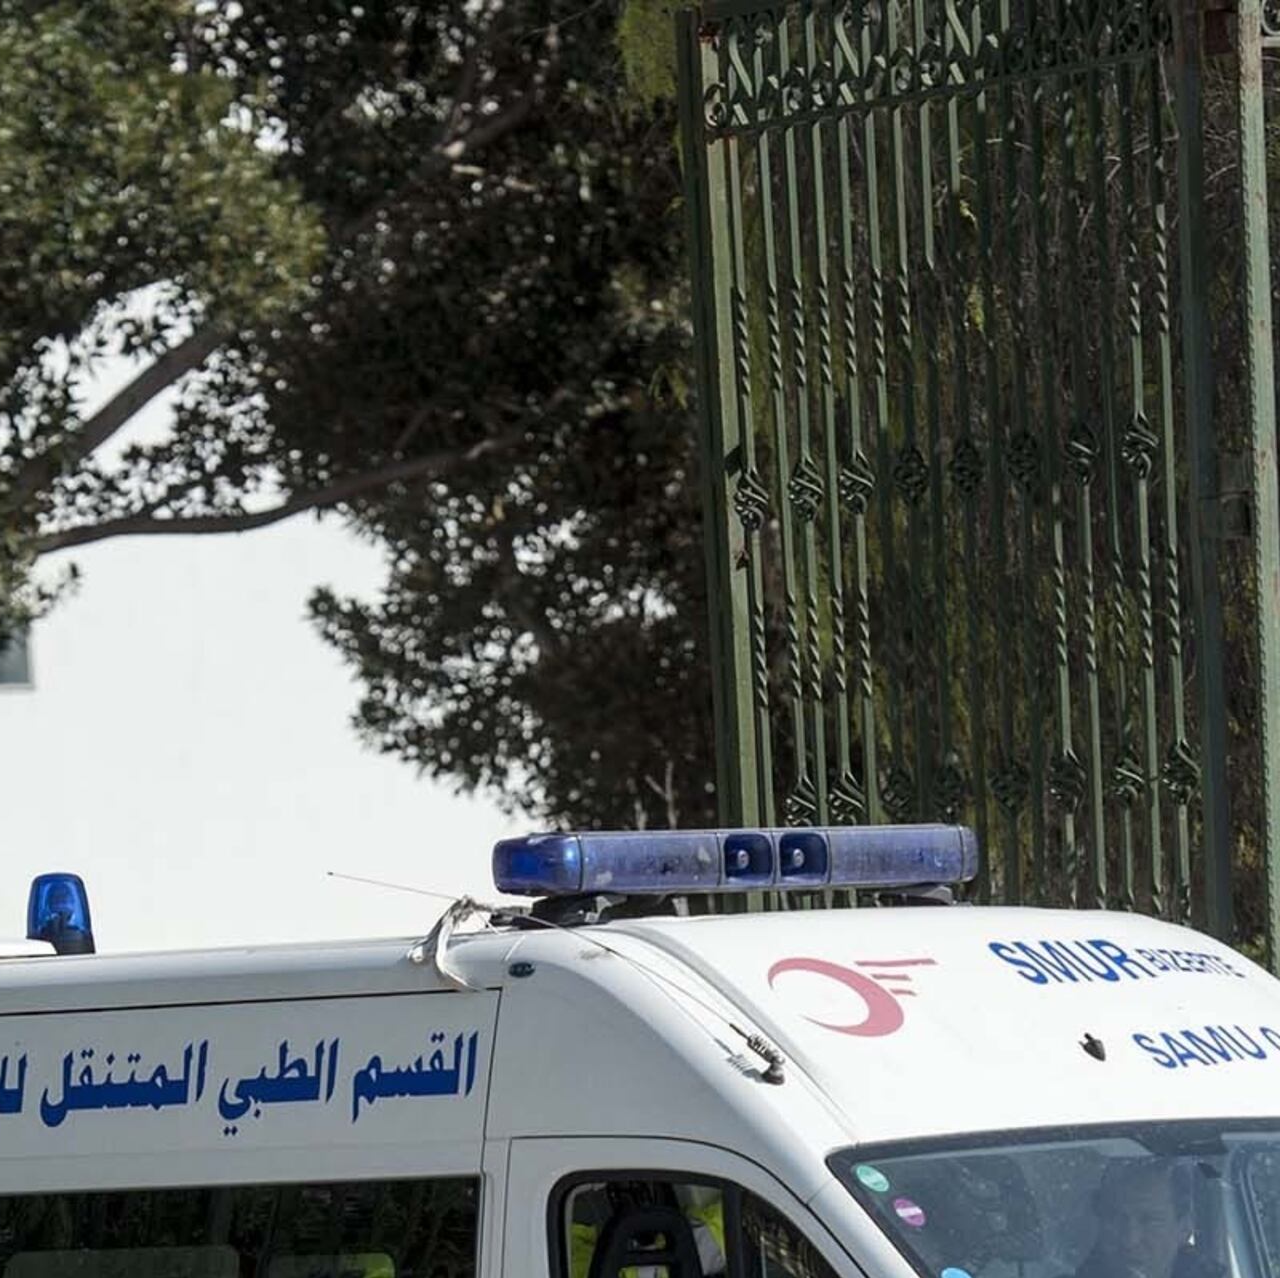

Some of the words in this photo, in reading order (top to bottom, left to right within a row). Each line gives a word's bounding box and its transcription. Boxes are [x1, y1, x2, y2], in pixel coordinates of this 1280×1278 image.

[988, 939, 1158, 985] SMUR
[1135, 948, 1246, 978] BIZERTE
[39, 1038, 210, 1129] المتنقل
[218, 1037, 340, 1137] الطبي
[352, 1030, 479, 1123] القسم
[1132, 1024, 1267, 1069] SAMU
